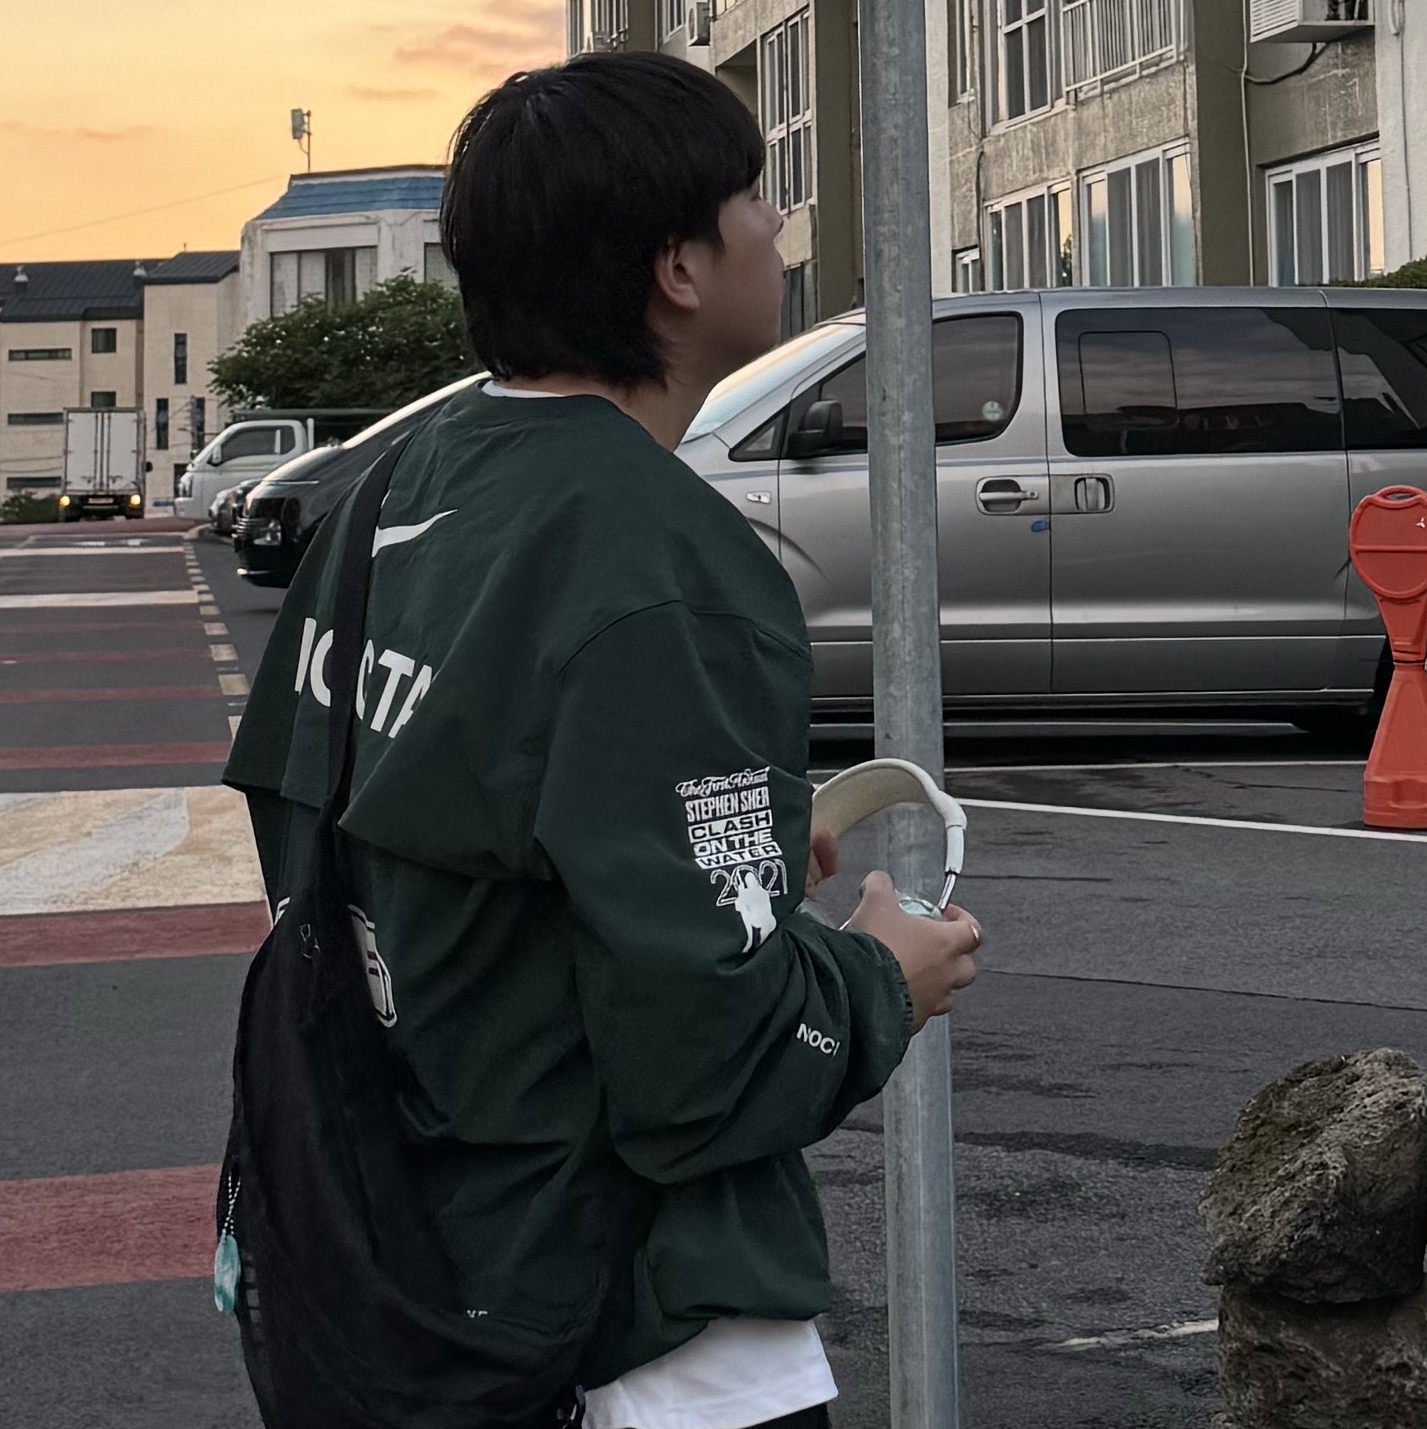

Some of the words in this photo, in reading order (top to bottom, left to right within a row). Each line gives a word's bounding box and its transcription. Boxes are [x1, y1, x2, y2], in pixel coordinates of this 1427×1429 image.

[684, 791, 740, 823] STEPHEN
[691, 811, 772, 840] CLASH
[693, 837, 728, 857] ON
[727, 827, 773, 848] THE
[699, 845, 779, 867] WATER
